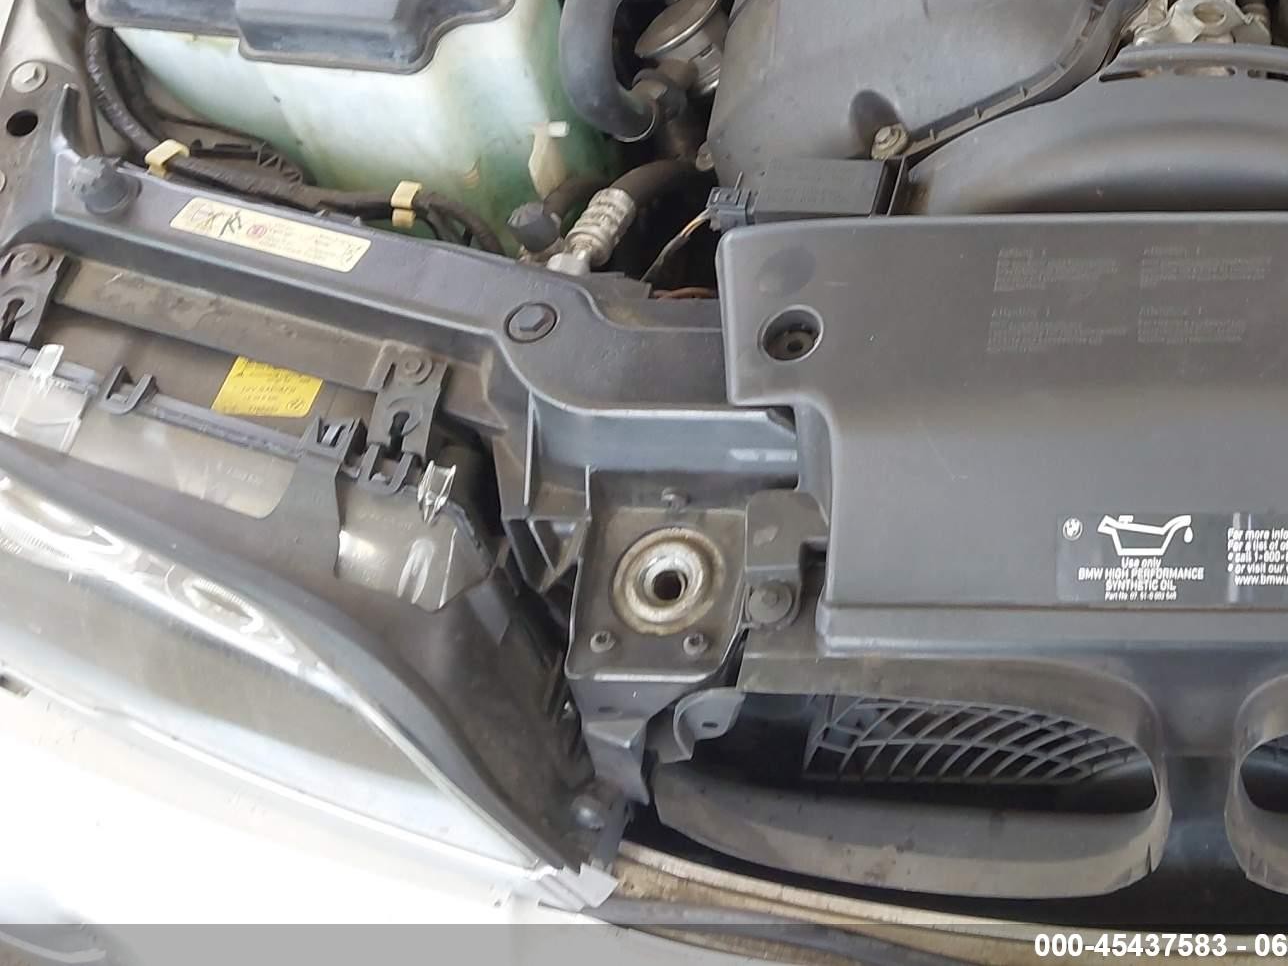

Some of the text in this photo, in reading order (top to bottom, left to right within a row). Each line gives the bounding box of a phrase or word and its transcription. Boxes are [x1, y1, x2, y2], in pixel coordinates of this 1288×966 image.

[1228, 528, 1243, 540] For
[1245, 530, 1269, 540] more
[1272, 528, 1288, 540] info
[1228, 540, 1243, 551] For
[1245, 542, 1252, 551] a
[1253, 540, 1267, 551] list
[1269, 540, 1278, 551] of
[1235, 551, 1251, 562] call
[1121, 557, 1161, 569] Use only
[1235, 564, 1246, 574] or
[1247, 563, 1266, 574] visit
[1268, 564, 1284, 574] our
[1078, 568, 1204, 580] BMW HIGH PERFORMANCE
[1105, 580, 1176, 591] SYNTHETIC OIL
